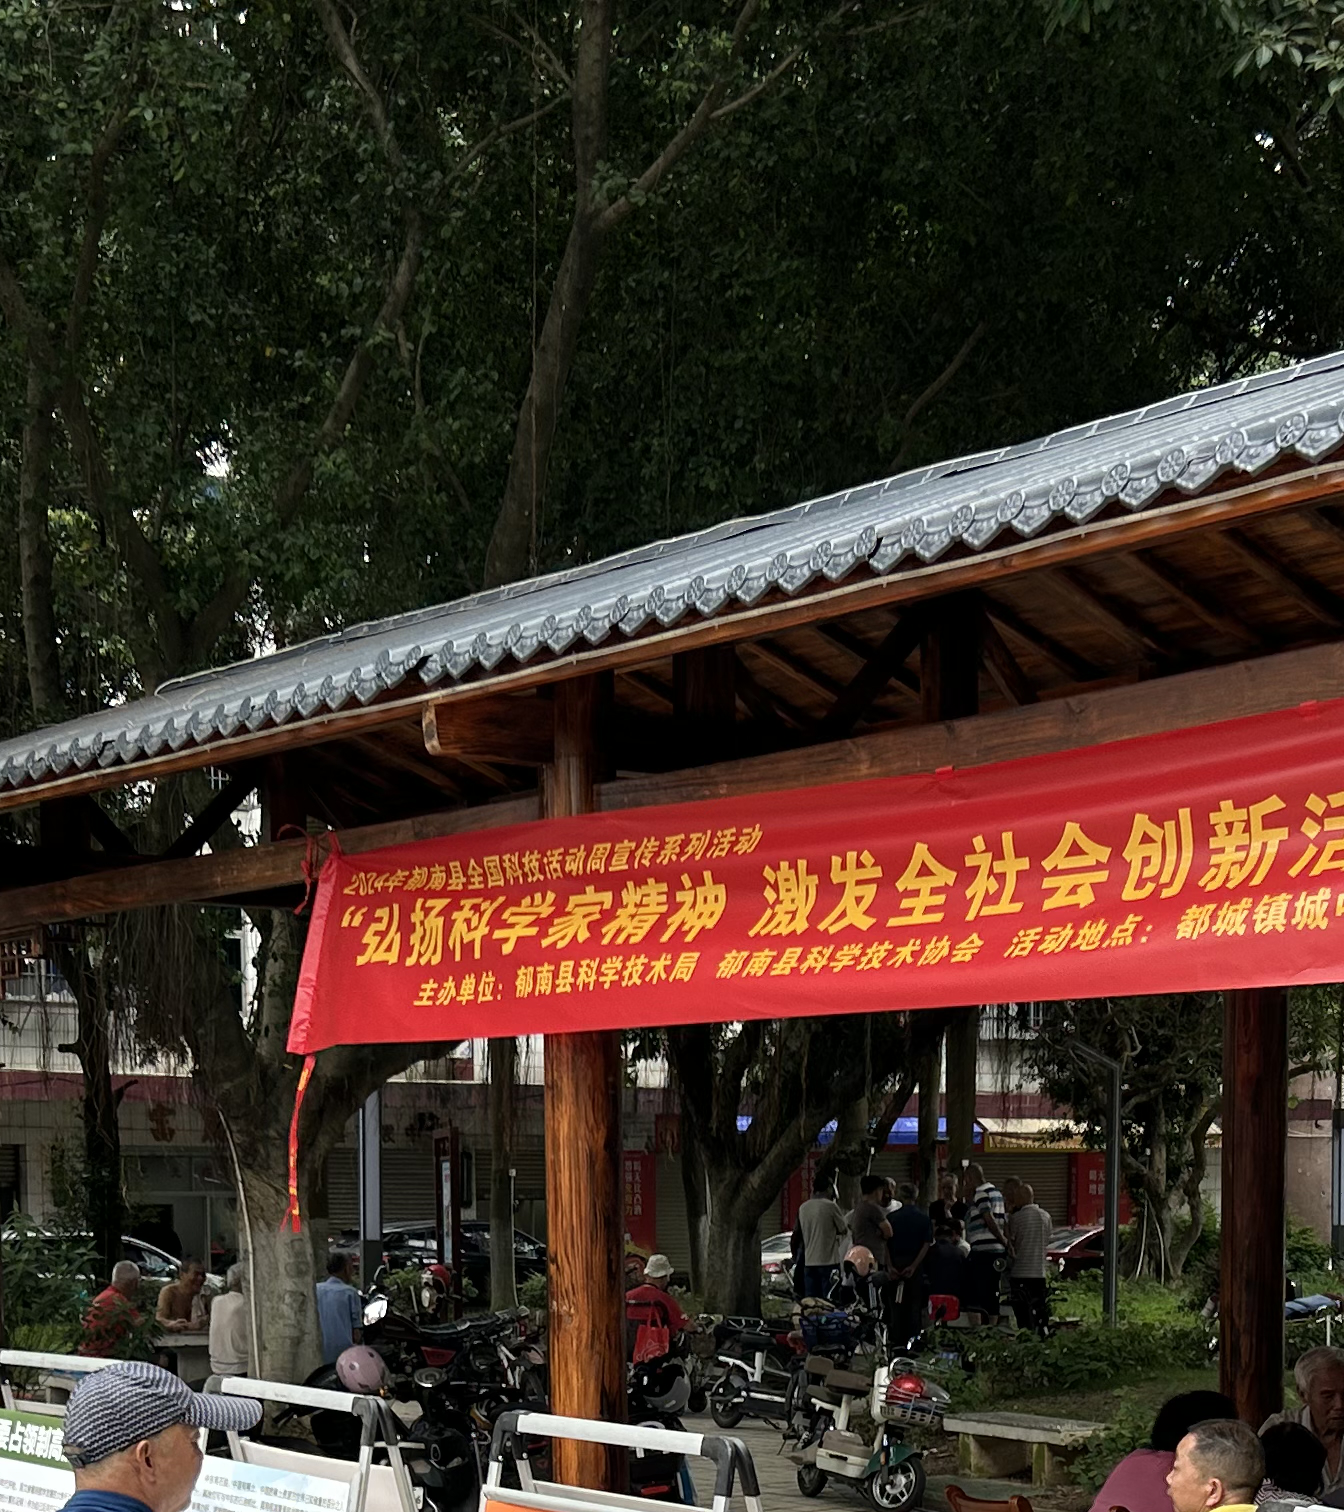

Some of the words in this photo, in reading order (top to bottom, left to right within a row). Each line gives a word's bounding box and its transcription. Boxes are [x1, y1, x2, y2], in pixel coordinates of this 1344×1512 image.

[345, 823, 763, 895] 2024年郁南县全国科技活动周宣传系列活动
[341, 874, 726, 966] “弘扬科学家精神
[716, 934, 983, 980] 郁南县科学技术协会
